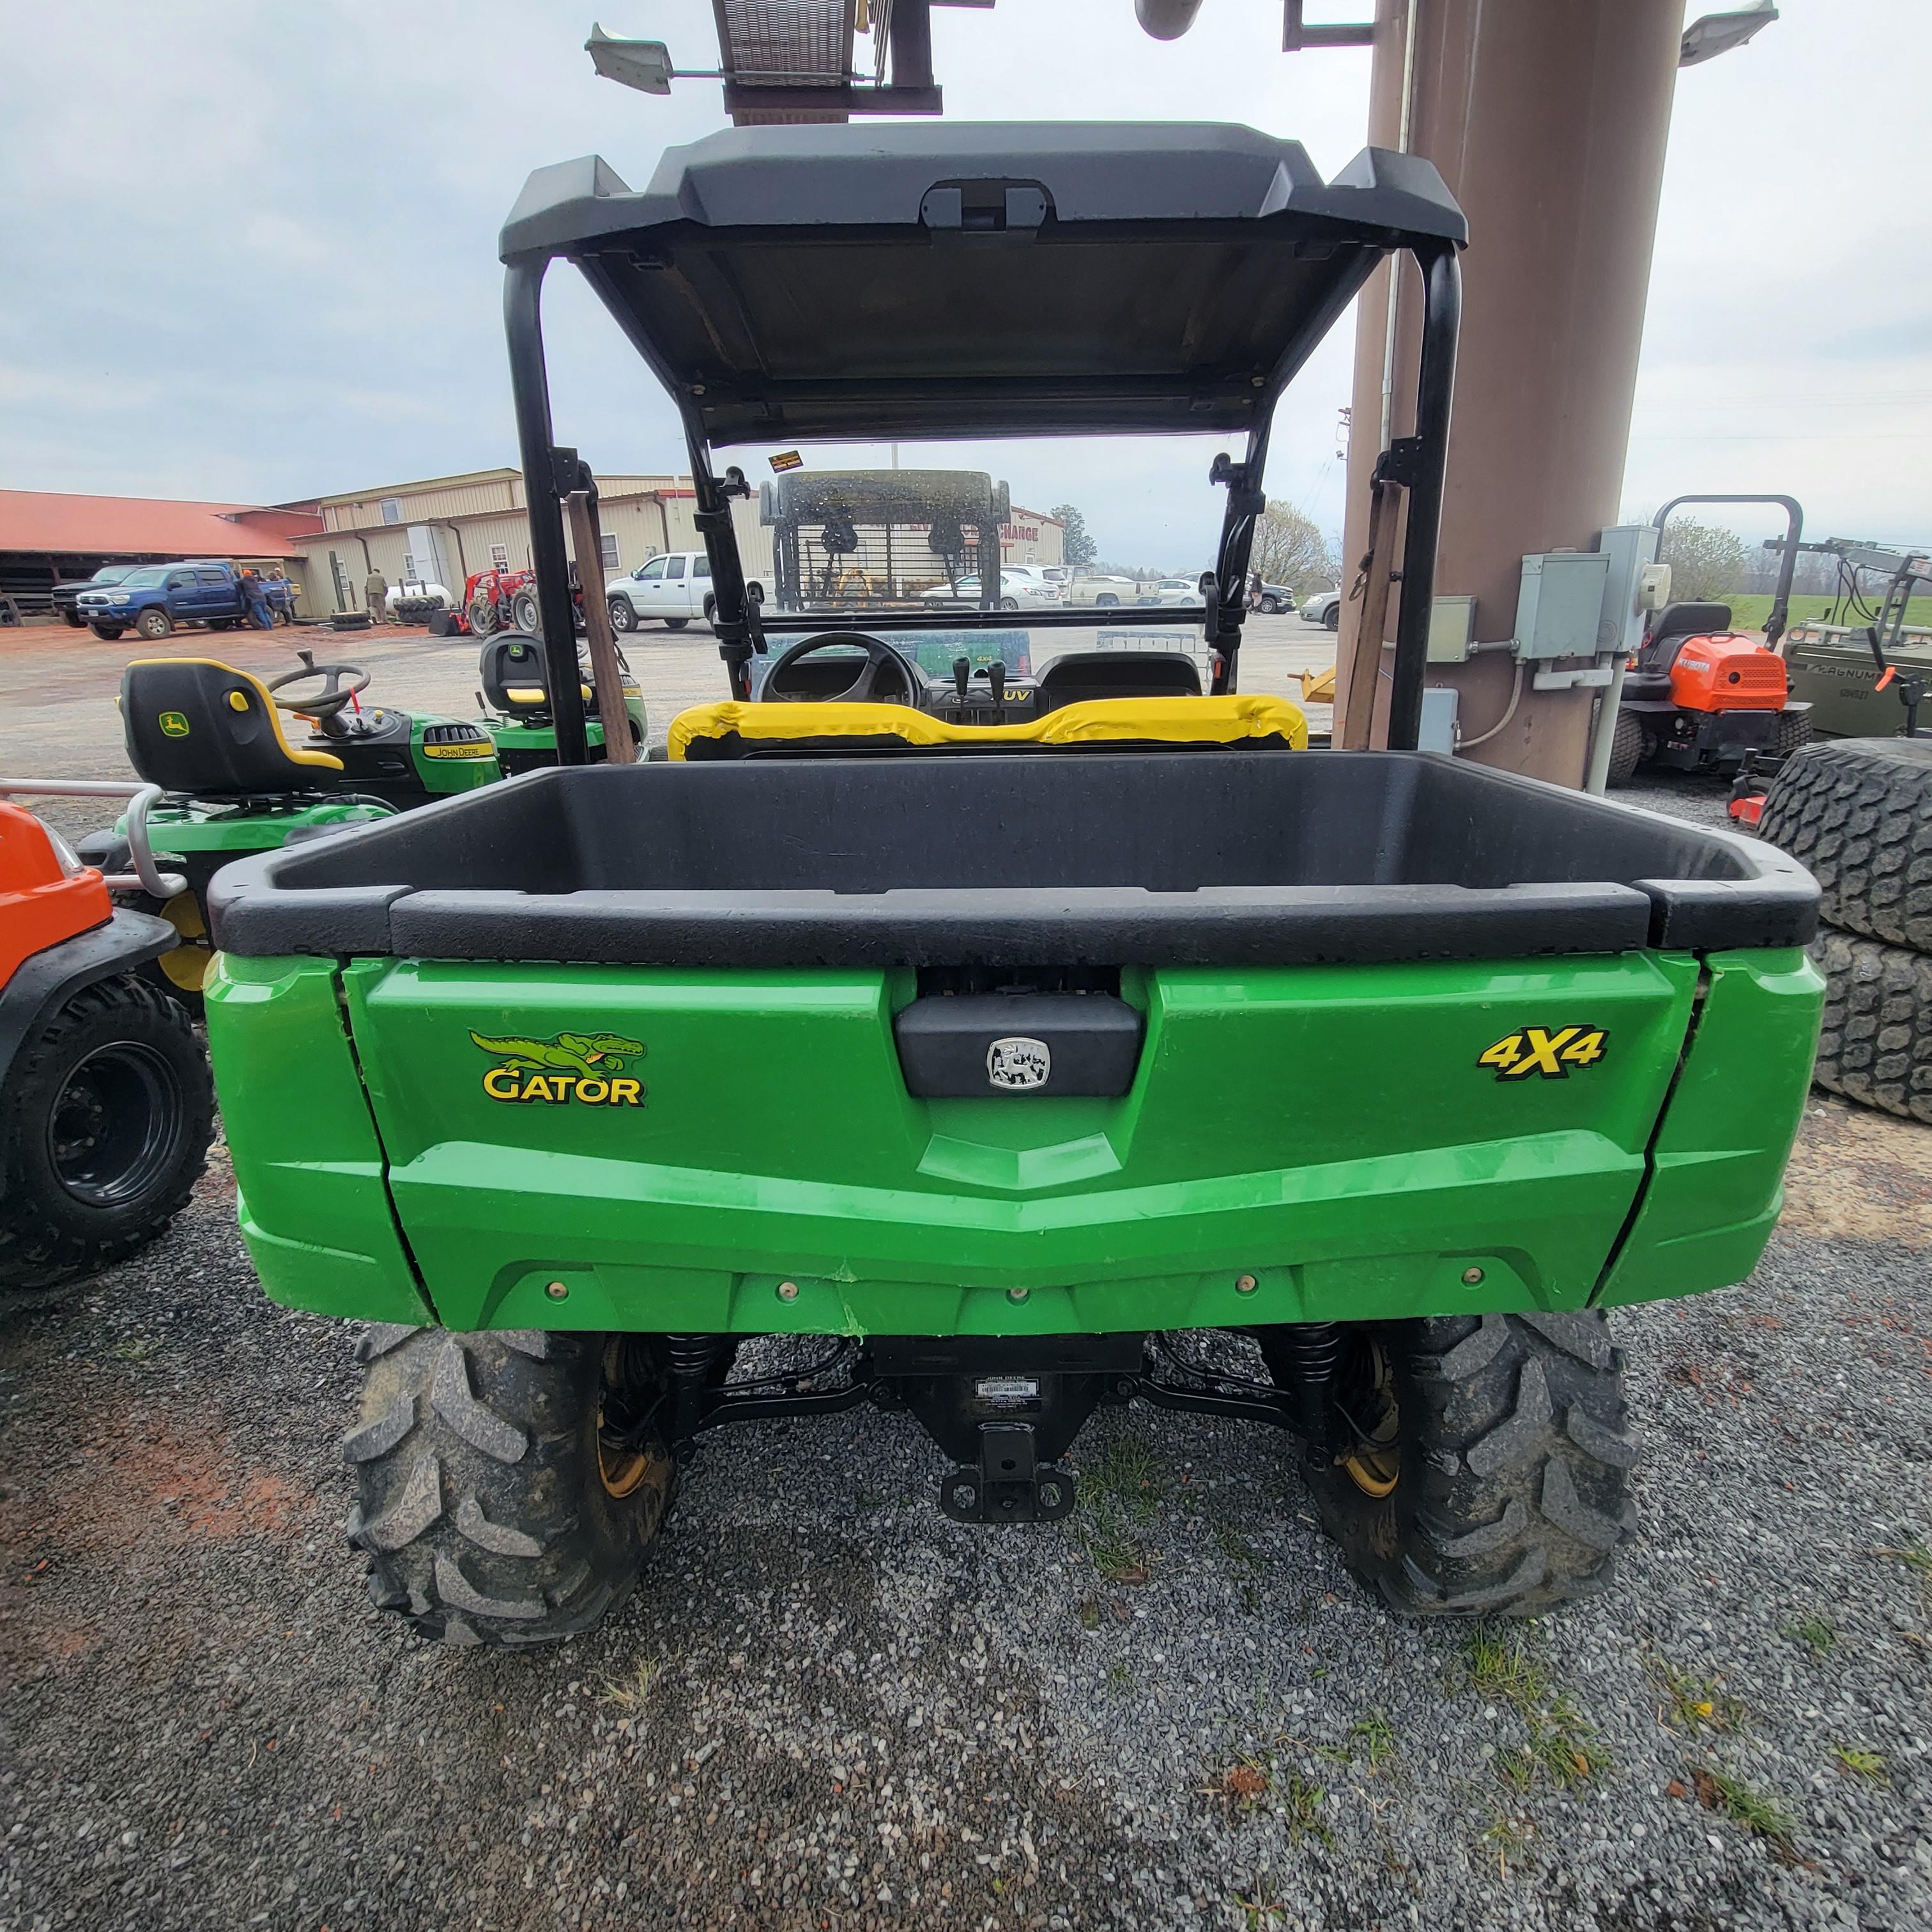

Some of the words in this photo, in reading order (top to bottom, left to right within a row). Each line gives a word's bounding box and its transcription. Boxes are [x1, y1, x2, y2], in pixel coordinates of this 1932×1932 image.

[1678, 657, 1710, 673] KUBOTA
[991, 690, 1031, 702] UV
[438, 747, 458, 757] JOHN
[458, 747, 479, 756] DEERE
[1479, 1027, 1604, 1075] 4X4
[484, 1068, 641, 1105] GATOR
